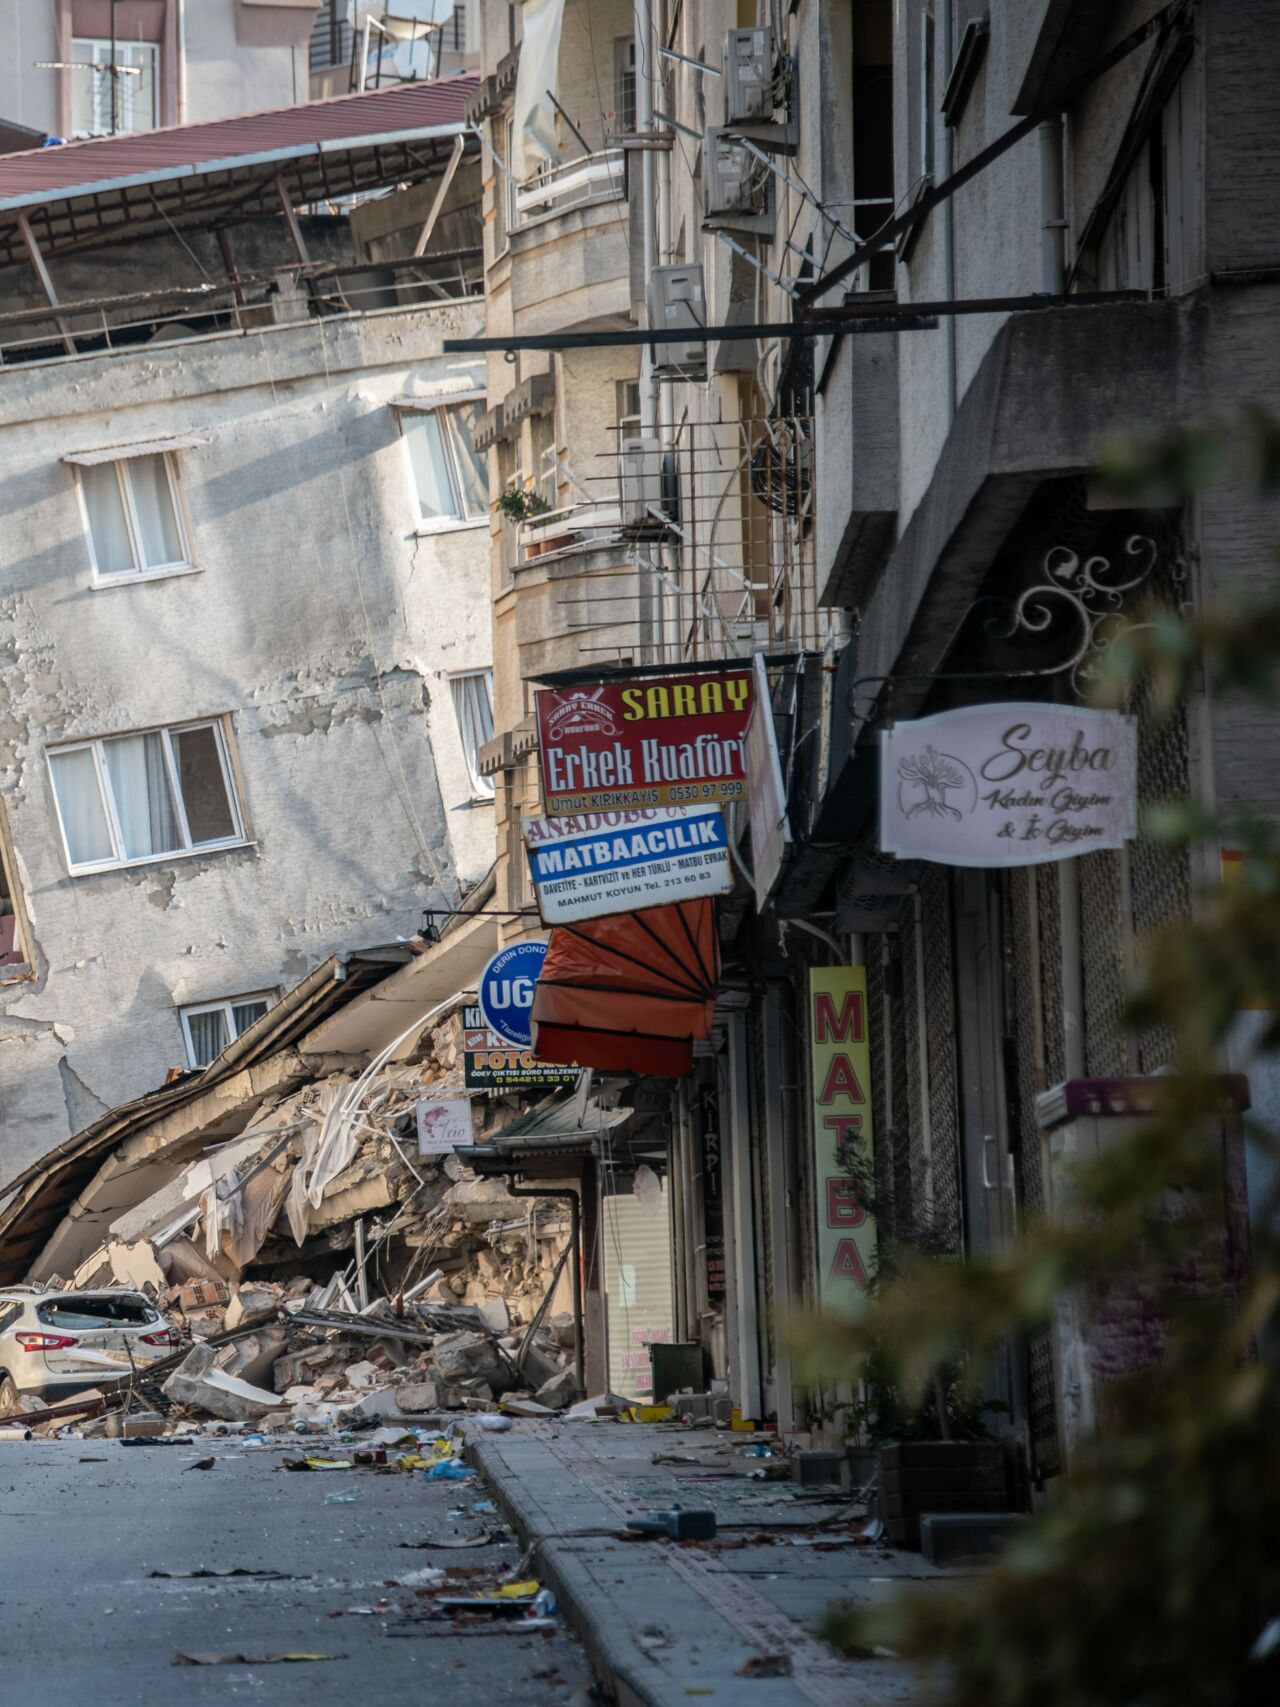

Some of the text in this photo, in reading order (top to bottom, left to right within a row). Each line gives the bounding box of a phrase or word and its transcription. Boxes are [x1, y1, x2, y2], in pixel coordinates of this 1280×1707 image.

[620, 679, 749, 722] SARAY
[546, 741, 635, 793] Erkek
[980, 722, 1115, 795] Seyba
[591, 790, 660, 807] KIRIKKAYIŞ
[669, 786, 698, 802] 0530
[702, 784, 717, 797] 97
[720, 782, 743, 796] 999
[537, 820, 720, 875] MATBAACILIK
[996, 821, 1016, 839] &
[543, 880, 577, 896] DAVETİYE
[584, 870, 620, 888] KARTVİZİT
[621, 872, 630, 881] ve
[631, 868, 647, 879] HER
[648, 861, 671, 876] TÜRLÜ
[678, 857, 703, 870] MATBU
[705, 851, 728, 865] EVRAK
[557, 892, 603, 907] MAHMUT
[606, 886, 641, 898] KOYUN
[645, 881, 661, 891] Tel.
[664, 877, 682, 886] 213
[685, 874, 697, 883] 60
